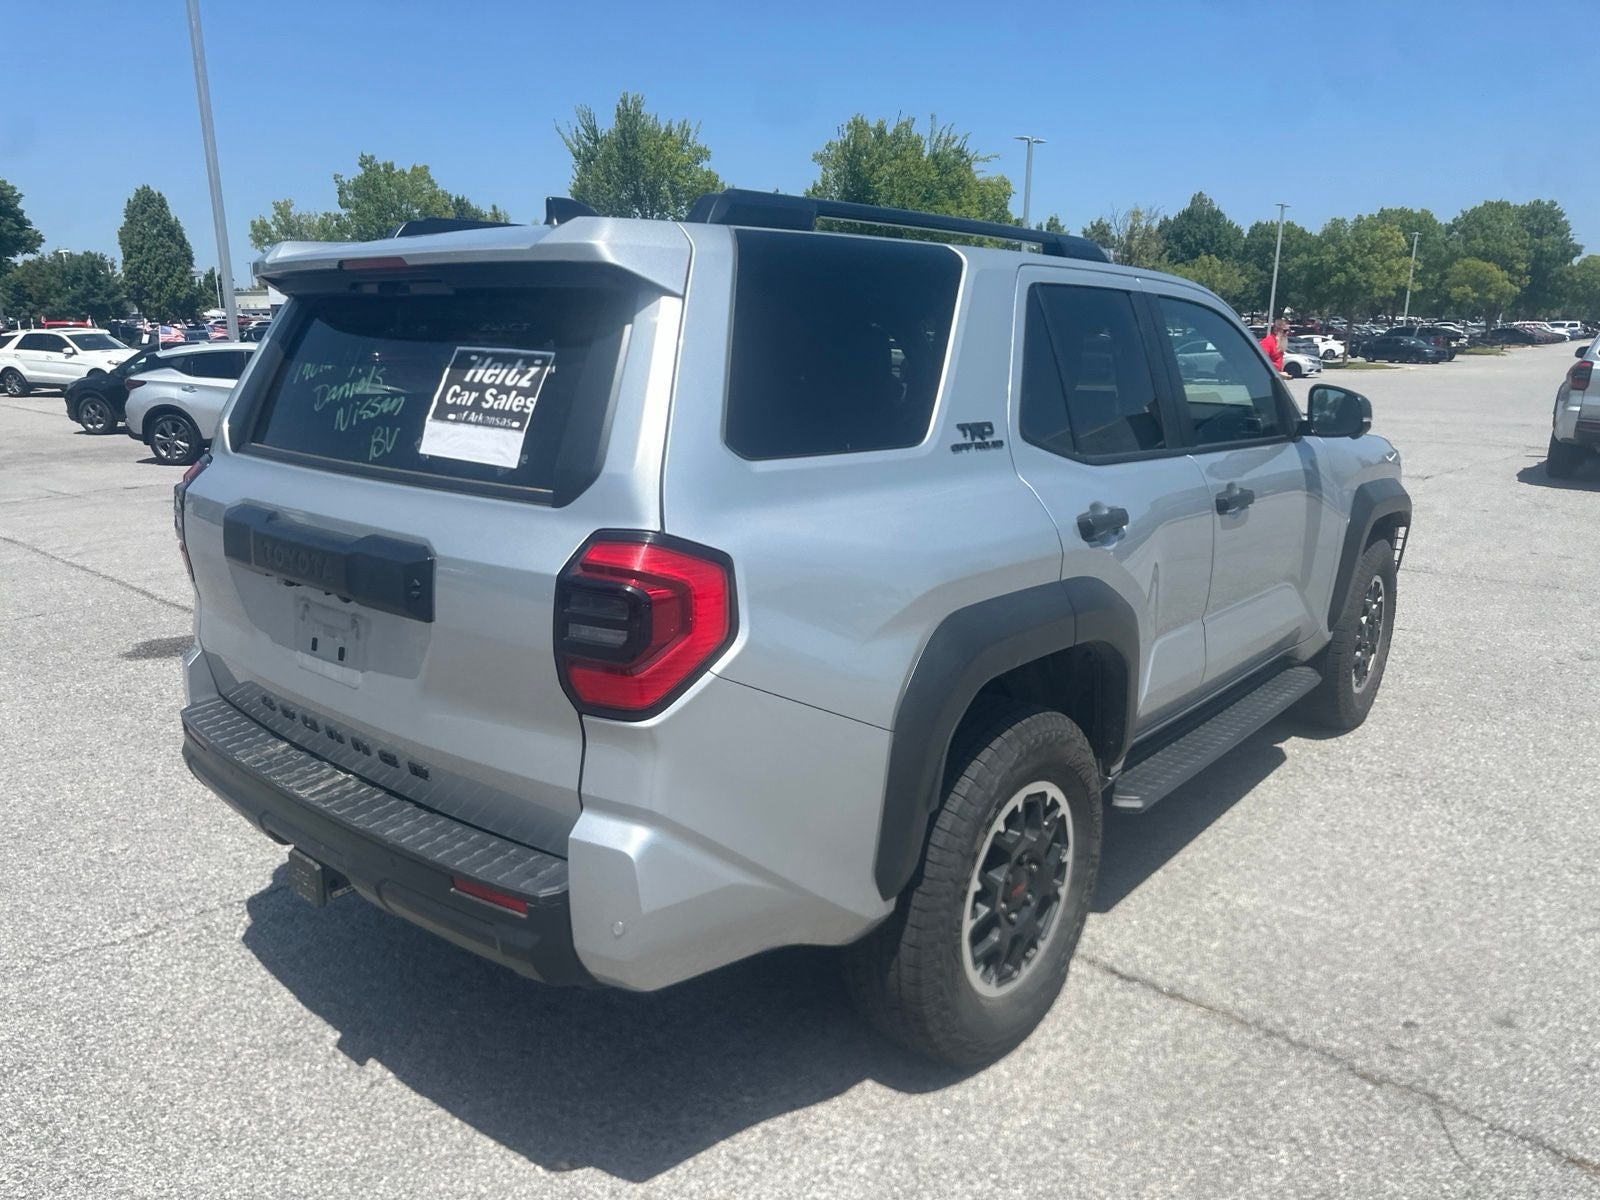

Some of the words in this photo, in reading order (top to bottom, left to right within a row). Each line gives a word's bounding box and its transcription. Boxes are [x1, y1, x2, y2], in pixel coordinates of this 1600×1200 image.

[463, 357, 541, 388] Hertz
[333, 396, 406, 432] Nissan
[445, 384, 480, 407] Car
[481, 388, 536, 414] Sales
[456, 411, 468, 422] of
[467, 412, 513, 426] Arkansas
[956, 422, 994, 441] TRD
[368, 425, 401, 462] BV
[263, 541, 332, 579] TOYOTA
